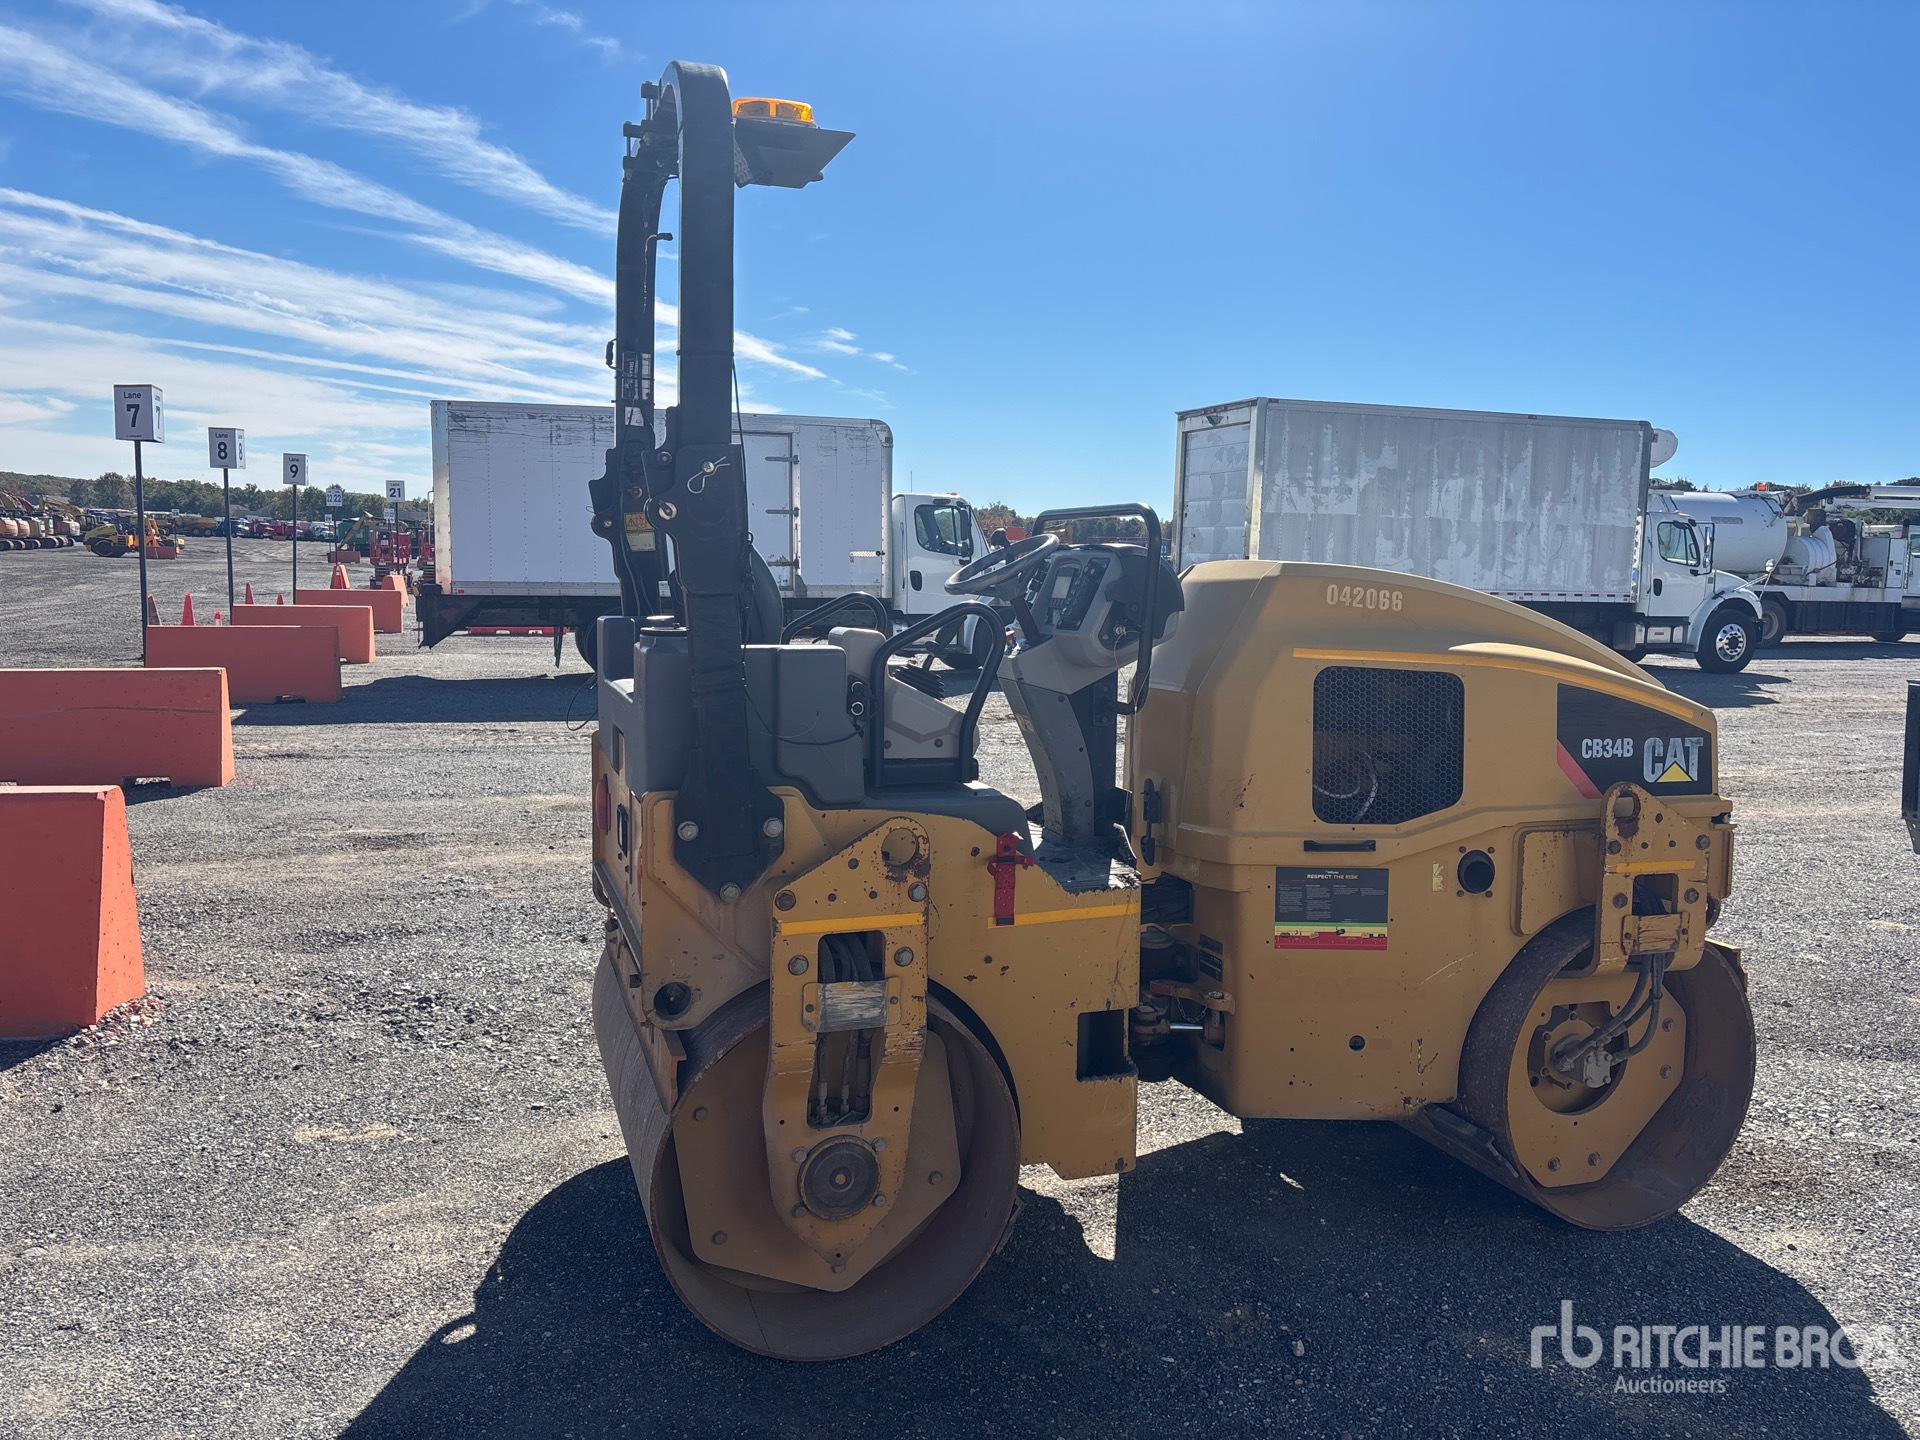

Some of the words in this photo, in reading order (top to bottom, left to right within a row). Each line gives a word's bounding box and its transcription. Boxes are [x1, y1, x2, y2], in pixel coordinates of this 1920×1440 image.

[123, 391, 142, 399] Lane
[126, 403, 140, 428] 7
[217, 441, 228, 460] 8
[289, 464, 299, 479] 9
[333, 493, 342, 503] 22
[389, 487, 401, 498] 21
[1326, 584, 1403, 612] 042066
[1581, 738, 1634, 759] CB34B
[1643, 736, 1704, 783] CAT
